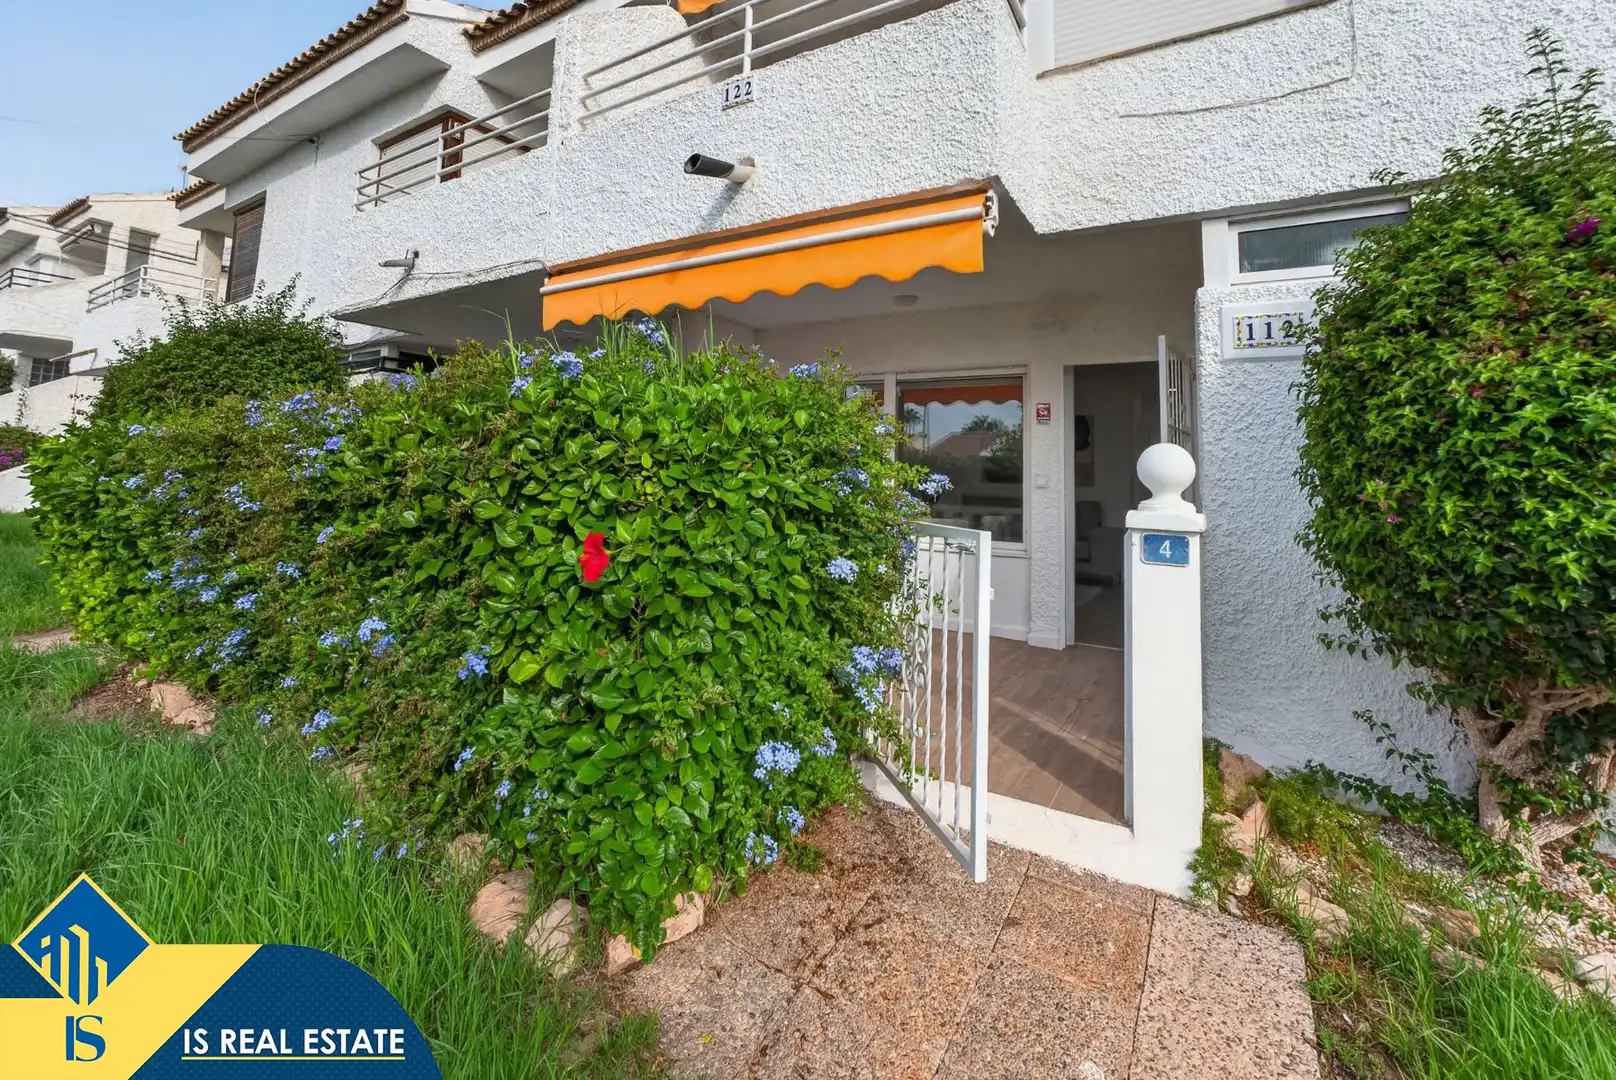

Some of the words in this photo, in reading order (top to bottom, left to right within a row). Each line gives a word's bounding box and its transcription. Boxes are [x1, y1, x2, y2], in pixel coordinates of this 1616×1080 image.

[724, 81, 752, 102] 122
[1246, 320, 1294, 341] 112
[1159, 540, 1172, 558] 4
